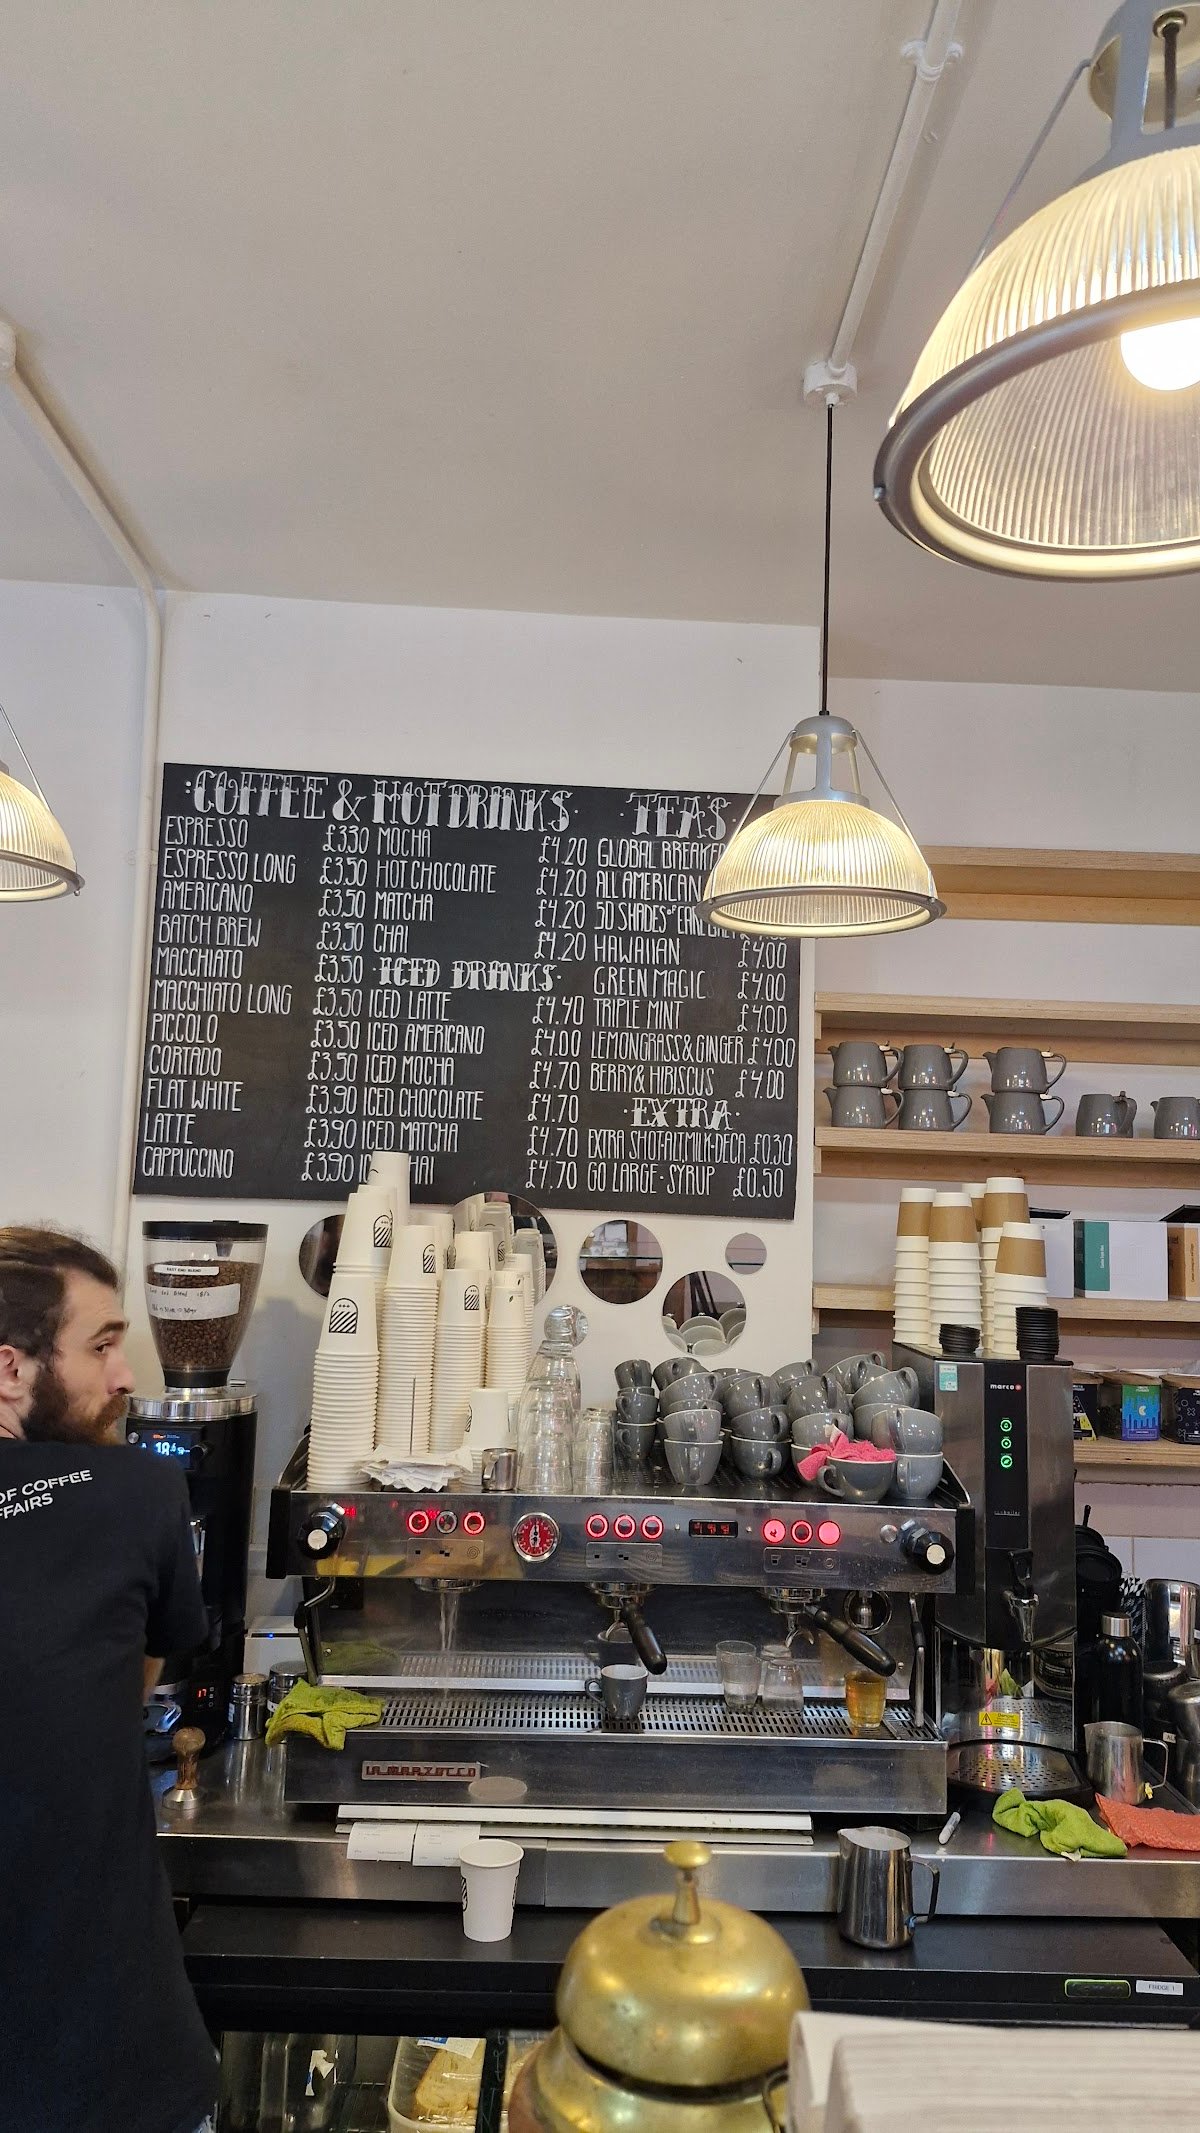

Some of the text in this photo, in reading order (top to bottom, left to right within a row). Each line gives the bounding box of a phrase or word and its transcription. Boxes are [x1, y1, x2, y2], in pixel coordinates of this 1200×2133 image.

[194, 770, 573, 832] COFFEE & HOT DRINKS
[626, 792, 731, 840] TEAS
[165, 816, 248, 848] ESPRESSO
[377, 827, 587, 866] MOCHA £4.20
[163, 849, 367, 886] ESPRESSO LONG £3.50
[598, 838, 656, 869] GLOBAL
[376, 860, 586, 897] HOT CHOCOLATE £4.20
[596, 870, 702, 902] ALL AMERICAN
[160, 882, 365, 918] AMERICANO £3.50
[374, 891, 586, 929] MATCHA £4.20
[618, 902, 666, 934] SHADES
[159, 914, 364, 952] BATCH BREW £3.50
[374, 924, 586, 961] CHAI £4.20
[156, 948, 363, 984] MACCHIATO £3.50
[594, 935, 786, 969] HAWAIIAN £4.00
[378, 956, 558, 992] ICED DRINKS
[594, 966, 786, 1002] GREEN MAGIC £4.00
[154, 980, 362, 1018] MACCHIATO LONG £3.50
[368, 989, 584, 1026] ICED LATTE £4.40
[593, 998, 787, 1034] TRIPLE MINT £4.00
[151, 1013, 360, 1050] PICCOLO £3.50
[367, 1022, 582, 1057] ICED AMERICANO £4.00
[150, 1046, 358, 1082] CORTADO £3.50
[696, 1034, 744, 1064] GINGER
[748, 1036, 796, 1068] £4.00
[365, 1055, 580, 1090] ICED MOCHA £4.70
[650, 1066, 714, 1096] HIBISCUS
[735, 1069, 785, 1100] £4.00
[147, 1079, 358, 1114] FLAT WHITE £3.90
[363, 1088, 578, 1123] ICED CHOCOLATE £4.70
[630, 1097, 734, 1130] EXTRA
[144, 1113, 356, 1150] LATTE £3.90
[361, 1120, 578, 1157] ICED MATCHA £4.70
[588, 1129, 624, 1159] EXTRA
[750, 1134, 792, 1166] £0.30
[142, 1146, 354, 1183] CAPPUCCINO £3.90
[408, 1155, 434, 1185] HAI
[526, 1160, 578, 1190] £4.70
[588, 1162, 784, 1198] GO LARGE SYRUP £0.50
[21, 1469, 93, 1496] COFFEE
